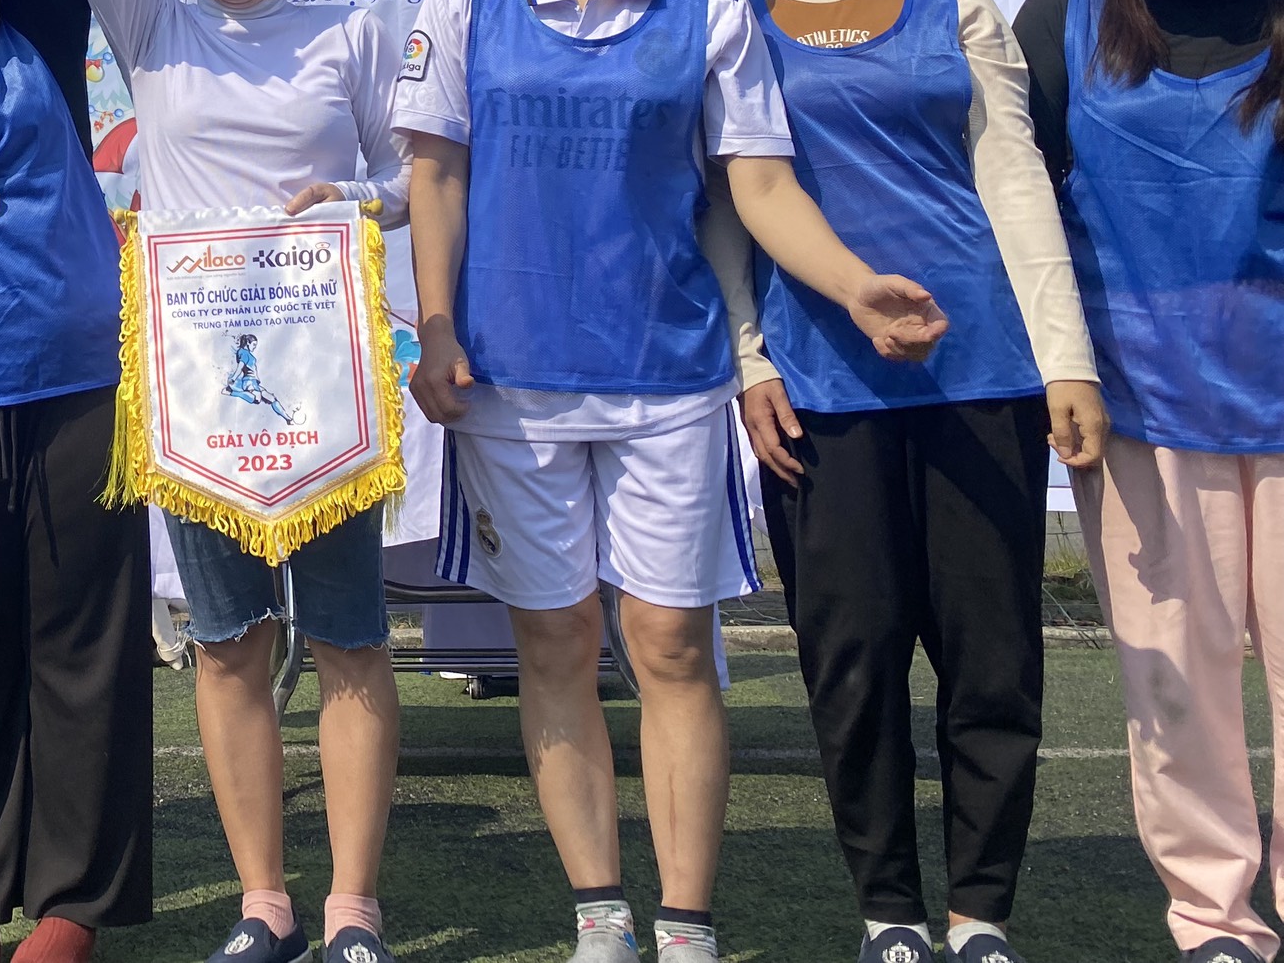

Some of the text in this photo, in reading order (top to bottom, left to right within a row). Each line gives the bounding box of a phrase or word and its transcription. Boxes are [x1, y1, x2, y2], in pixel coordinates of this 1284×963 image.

[796, 28, 871, 47] ATHLETICS
[253, 245, 331, 272] Kaigo
[166, 291, 188, 306] BAN
[208, 284, 238, 303] CHỨC
[240, 283, 266, 302] GIẢI
[269, 281, 300, 300] BÓNG
[302, 279, 319, 297] ĐÁ
[321, 278, 338, 297] NỮ
[171, 306, 196, 318] CÔNG
[198, 309, 209, 318] TY
[211, 307, 223, 316] CP
[225, 304, 251, 315] NHÂN
[253, 305, 271, 316] LỰC
[315, 299, 336, 311] VIỆT
[193, 321, 222, 330] TRUNG
[224, 319, 242, 328] TÂM
[265, 317, 282, 328] TẠO
[284, 315, 316, 325] VILACO
[206, 428, 319, 449] GIẢI VÔ ĐỊCH
[237, 454, 293, 472] 2023
